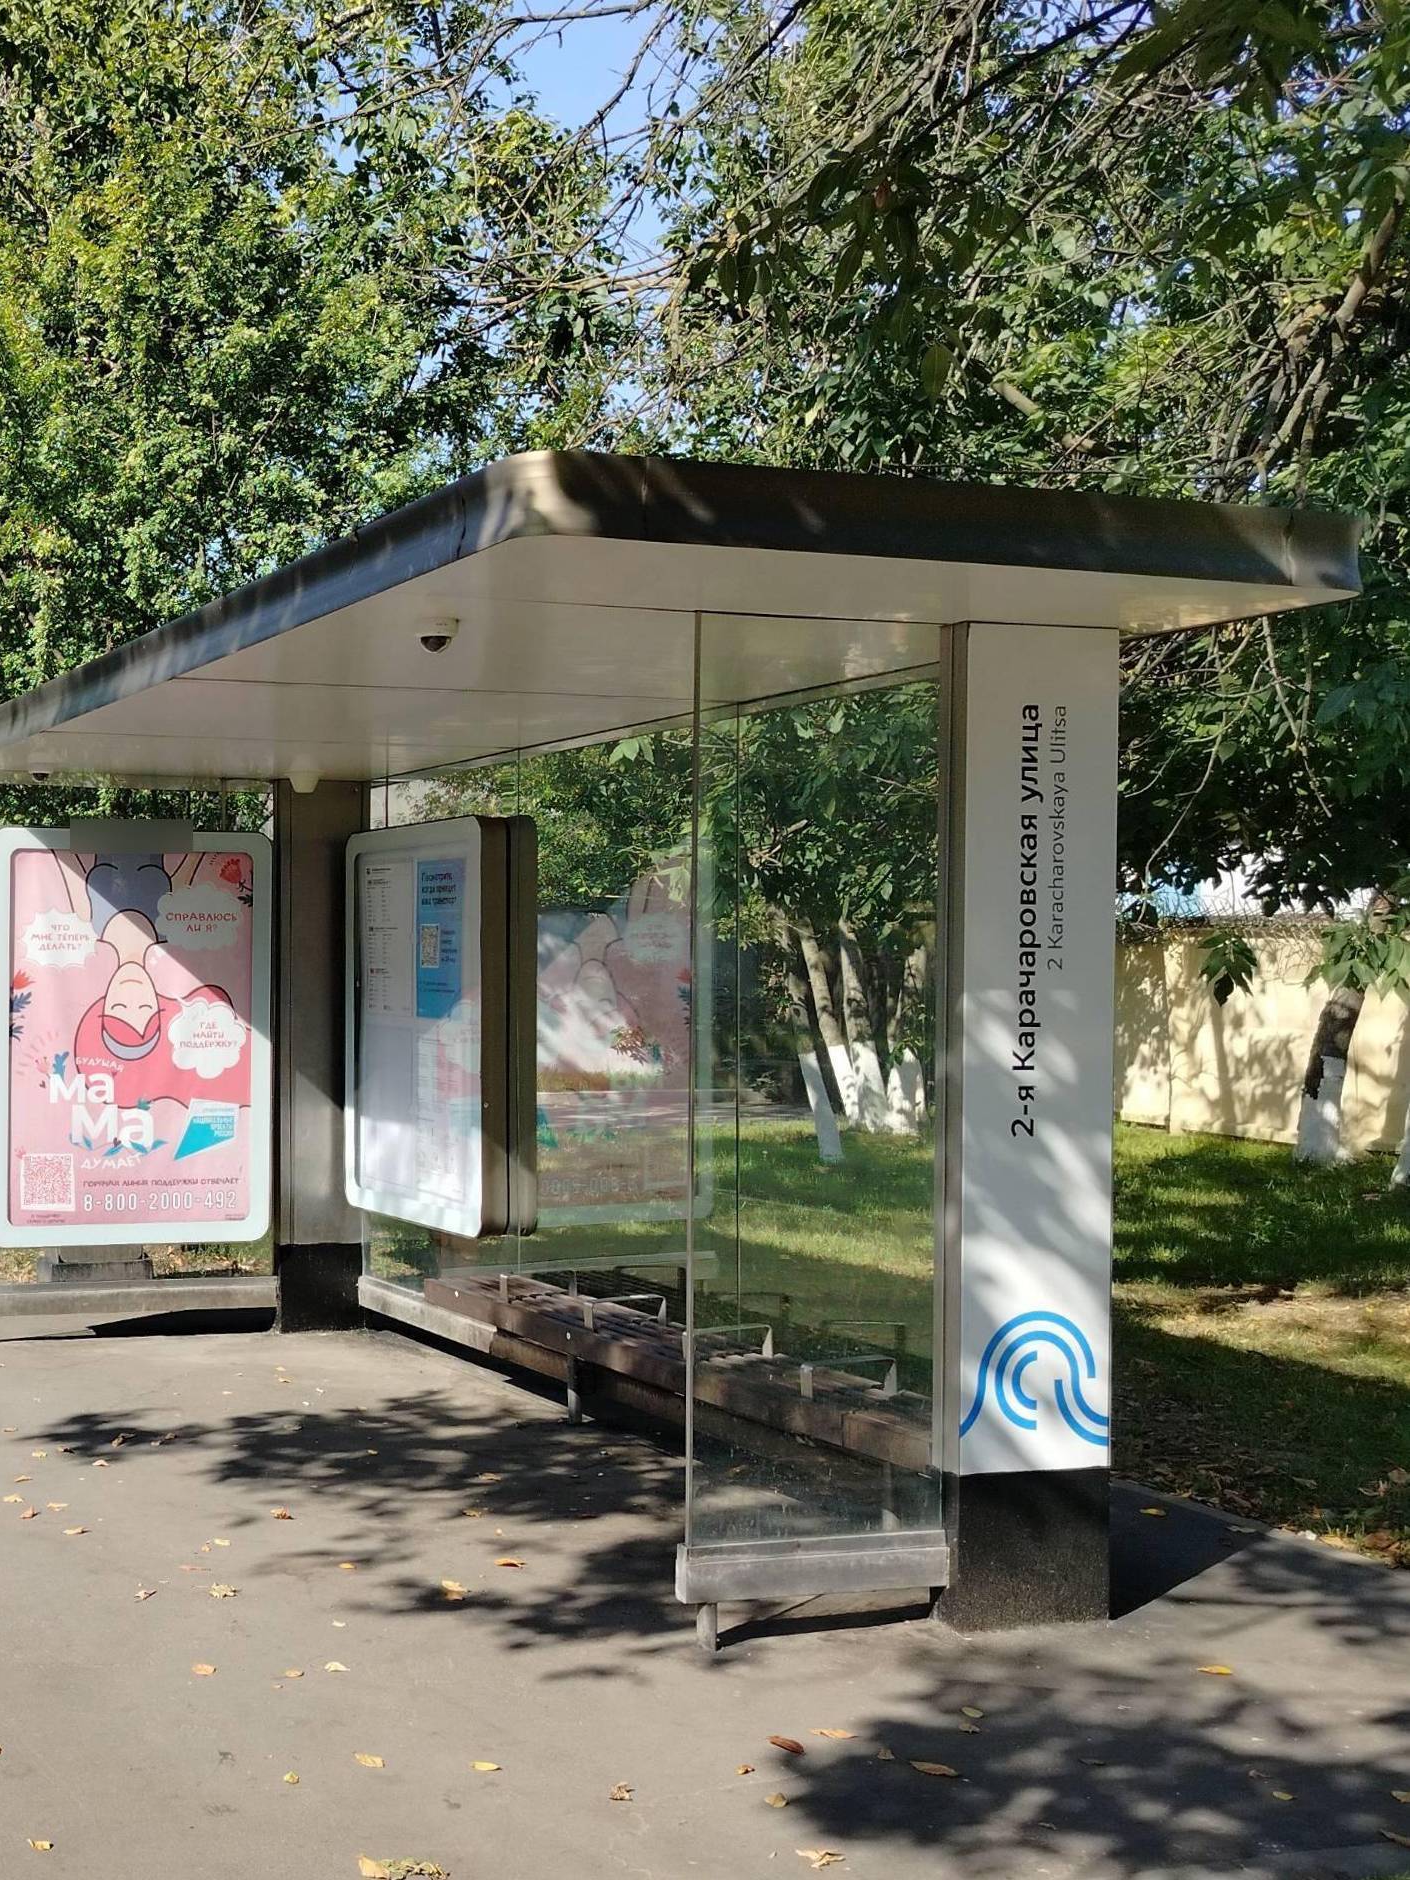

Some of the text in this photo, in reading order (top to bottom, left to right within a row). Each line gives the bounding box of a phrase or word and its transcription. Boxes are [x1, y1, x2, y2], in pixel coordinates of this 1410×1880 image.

[1047, 705, 1069, 971] 2 Karacharovskaya Ulitsa
[165, 911, 238, 921] СПРАВЛЮСЬ
[1010, 704, 1043, 1137] 2-я Карачаровская улица
[50, 923, 71, 931] ЧТО
[186, 923, 201, 932] ЛИ
[31, 932, 53, 941] МНЕ
[80, 1153, 142, 1169] ДУМАЕТ
